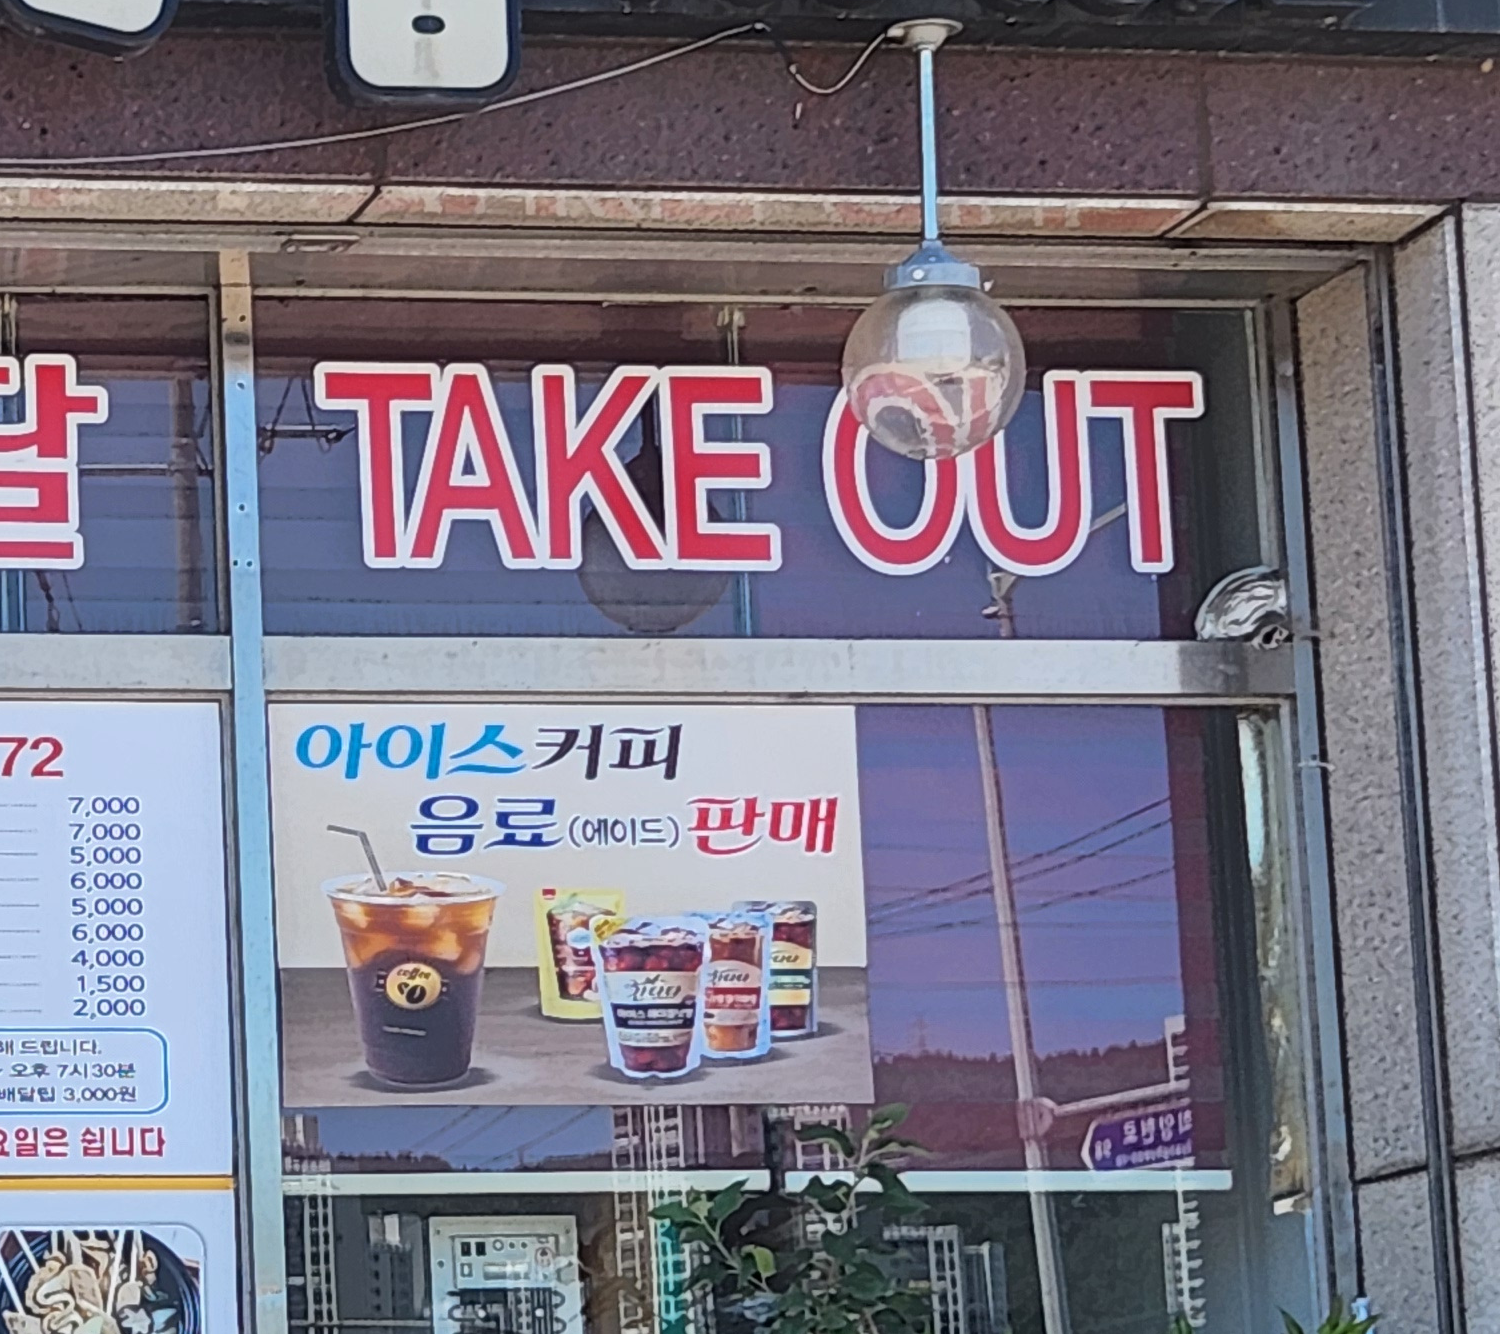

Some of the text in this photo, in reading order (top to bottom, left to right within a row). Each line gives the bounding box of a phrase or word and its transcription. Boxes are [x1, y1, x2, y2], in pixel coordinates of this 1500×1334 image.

[314, 361, 1205, 578] TAKE OUT
[294, 721, 683, 781] 아이스커피
[68, 796, 141, 817] 7,000
[69, 822, 142, 843] 7,000
[410, 793, 839, 856] 음료 (에이드) 판매
[69, 845, 142, 866] 5,000
[70, 871, 143, 892] 6,000
[71, 897, 144, 918] 5,000
[71, 923, 144, 944] 6,000
[71, 949, 145, 970] 4,000
[77, 975, 145, 996] 1,500
[72, 999, 146, 1020] 2,000
[9, 1063, 50, 1080] 오후
[62, 1086, 137, 1104] 3,000원
[80, 1126, 167, 1159] 쉽니다
